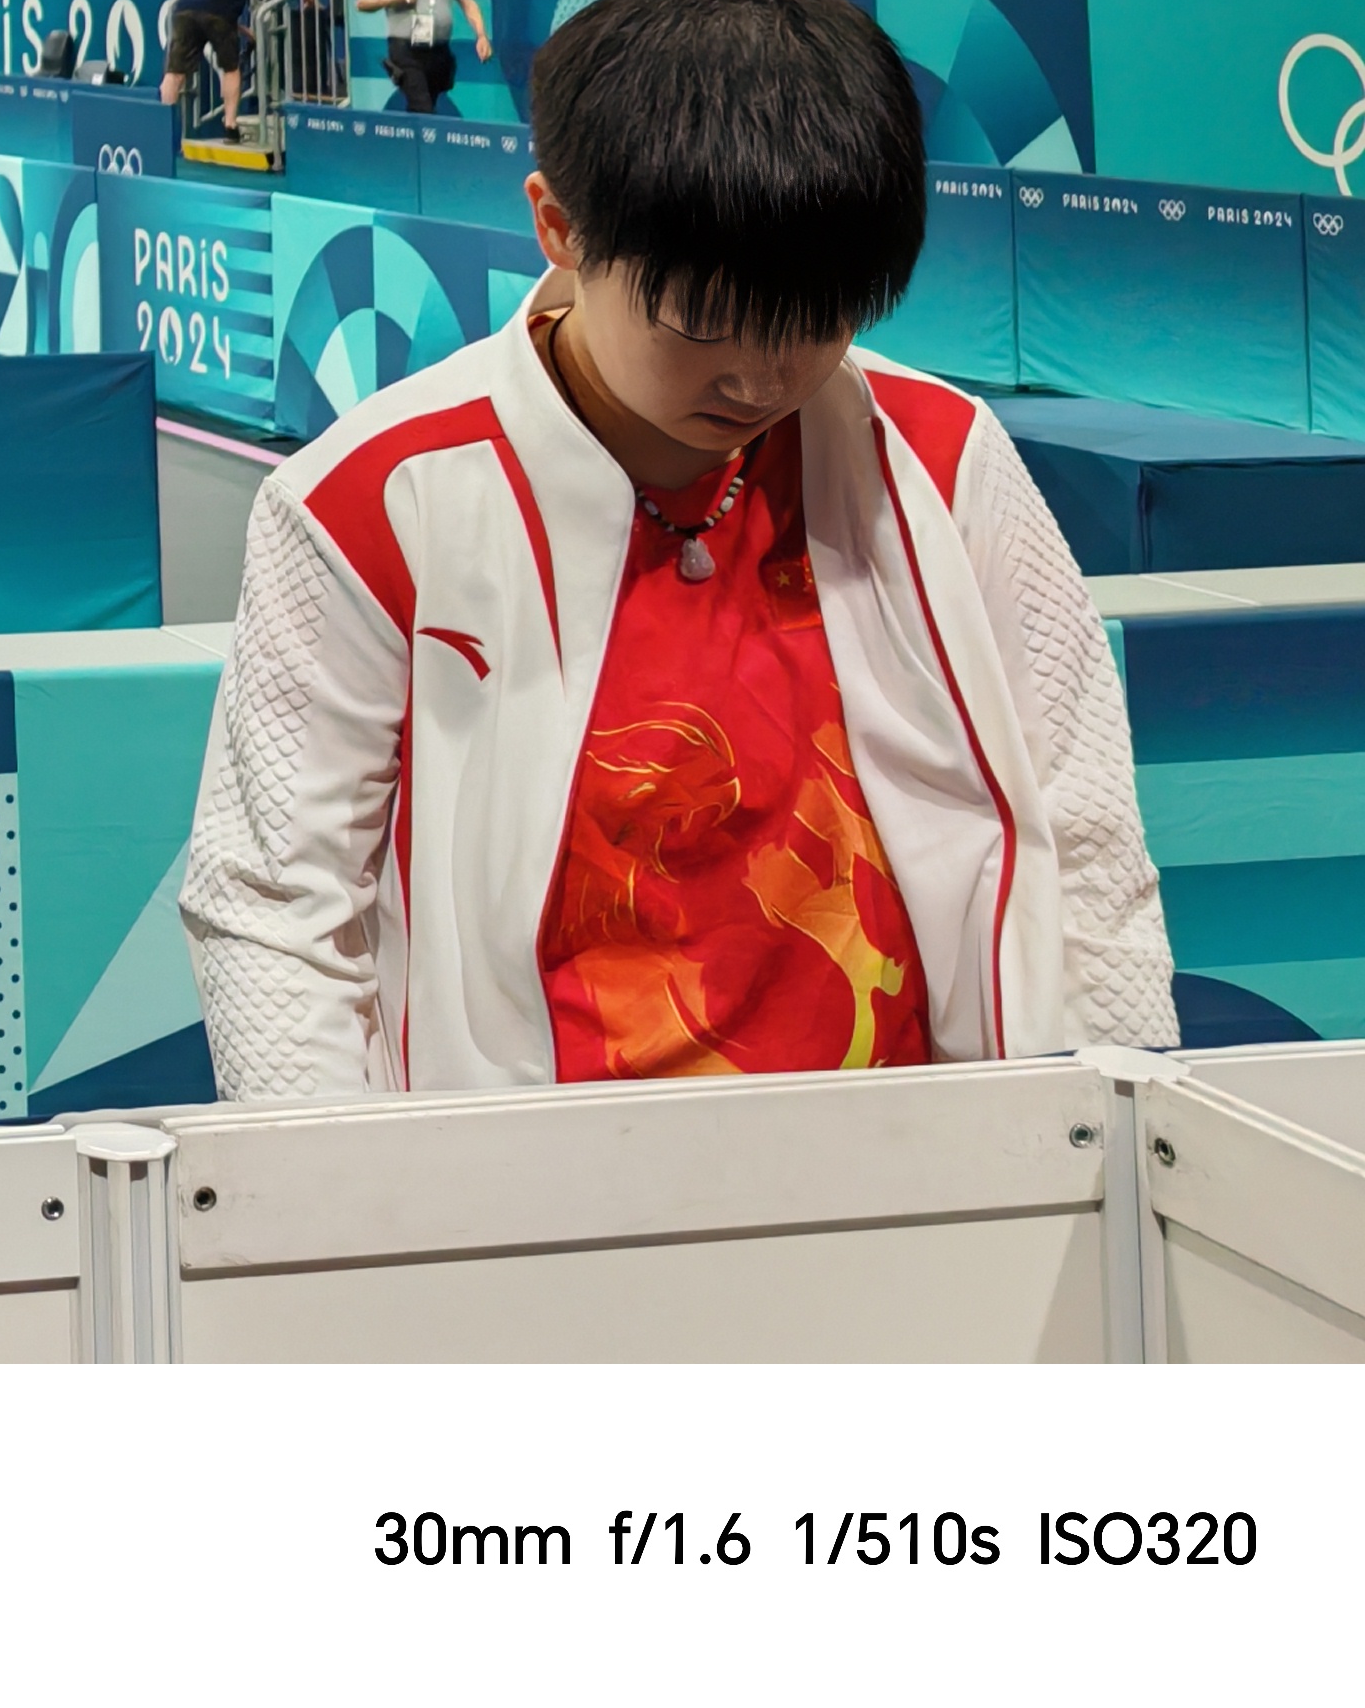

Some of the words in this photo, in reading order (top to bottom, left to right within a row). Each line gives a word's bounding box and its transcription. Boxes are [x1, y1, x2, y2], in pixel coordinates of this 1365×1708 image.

[971, 182, 1003, 199] 2024
[1103, 196, 1138, 214] 2024
[1253, 210, 1293, 228] 2024
[136, 300, 231, 380] 2024
